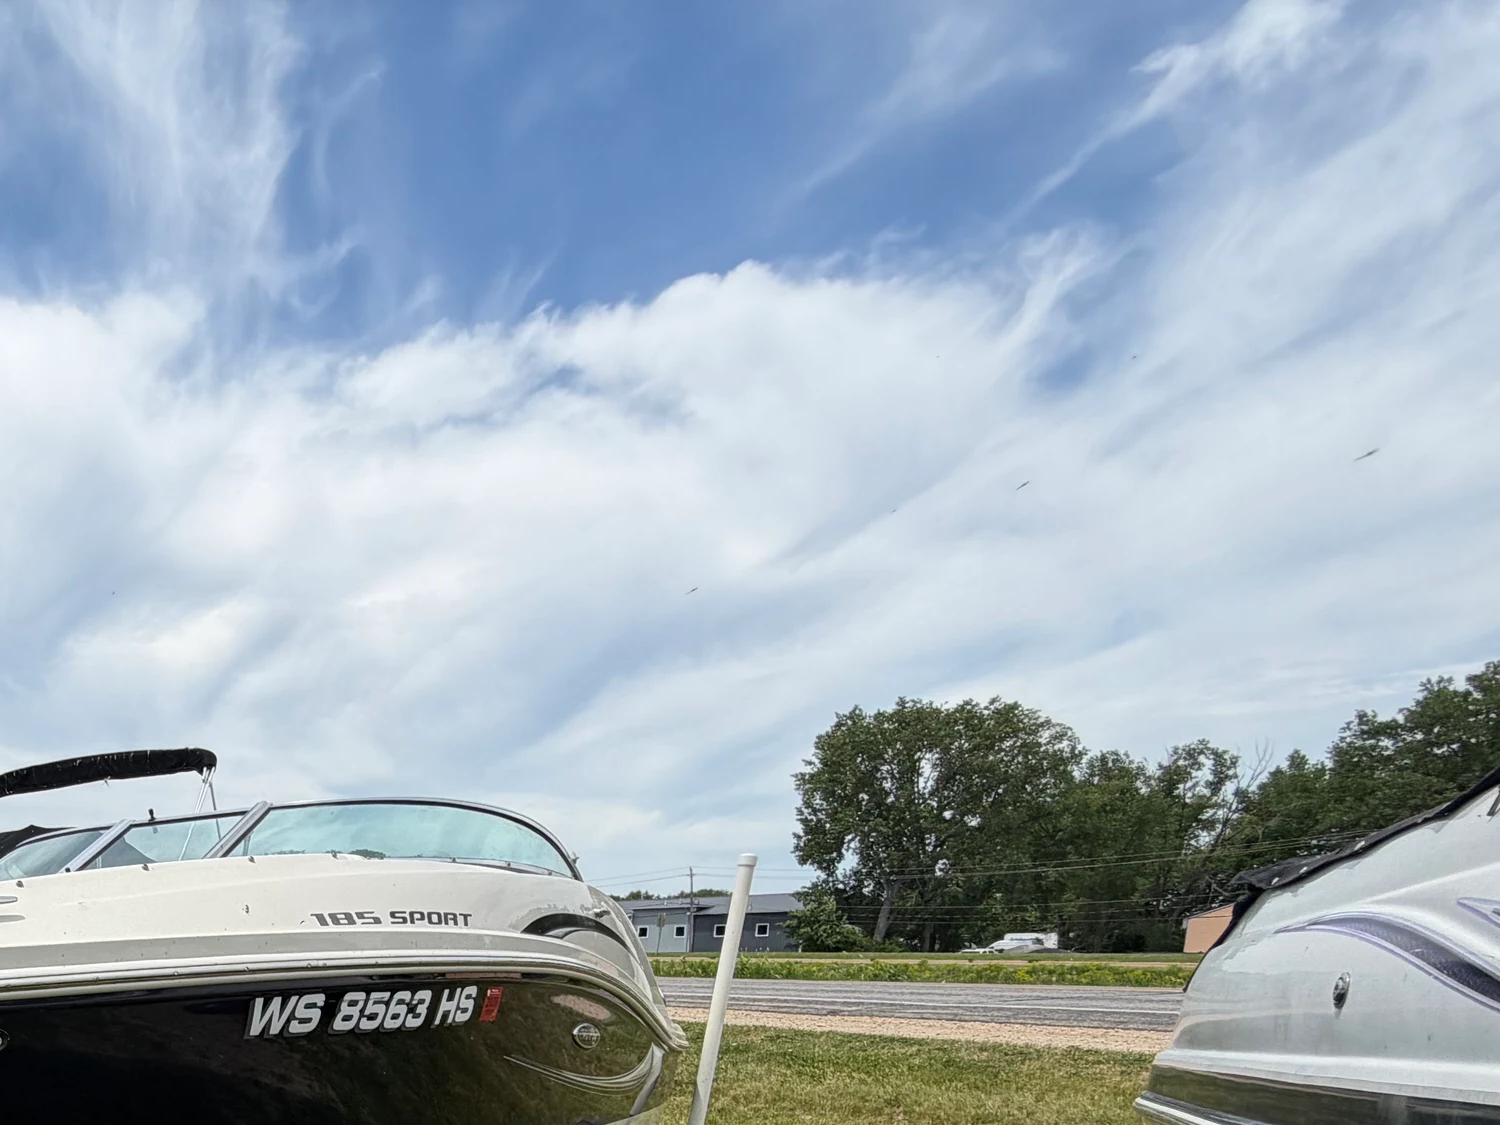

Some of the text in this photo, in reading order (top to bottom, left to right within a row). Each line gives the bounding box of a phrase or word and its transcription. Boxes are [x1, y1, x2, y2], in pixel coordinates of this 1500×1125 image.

[310, 911, 473, 927] 185 SPORT
[247, 993, 326, 1038] WS
[330, 990, 432, 1033] 8563
[433, 985, 478, 1026] HS
